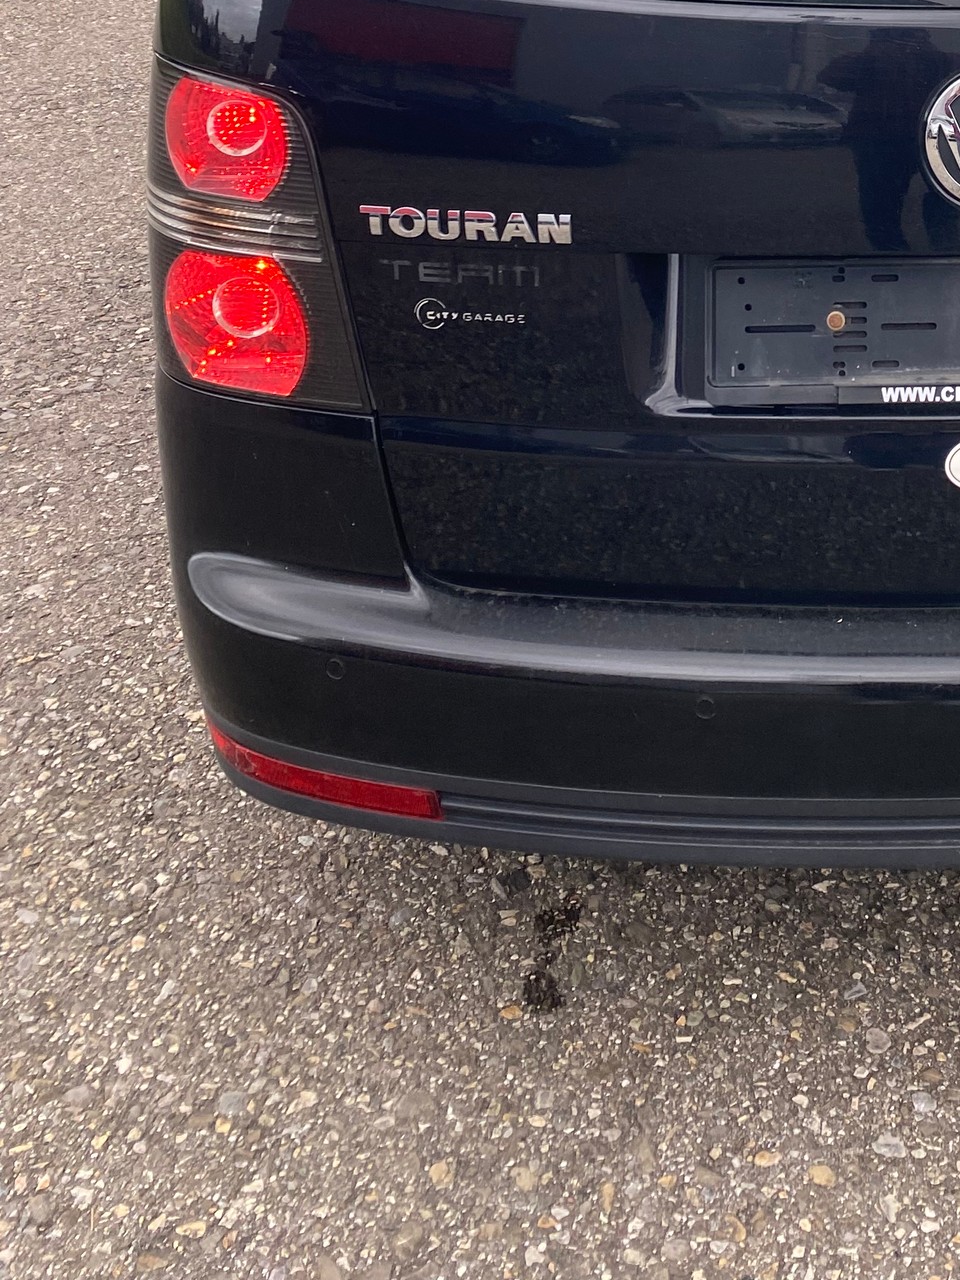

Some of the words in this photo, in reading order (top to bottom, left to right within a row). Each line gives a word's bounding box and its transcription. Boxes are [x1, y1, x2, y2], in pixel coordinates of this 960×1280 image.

[359, 204, 572, 245] TOURAN
[379, 258, 540, 288] TEAM
[426, 310, 459, 320] CITY
[462, 312, 526, 324] GARAGE
